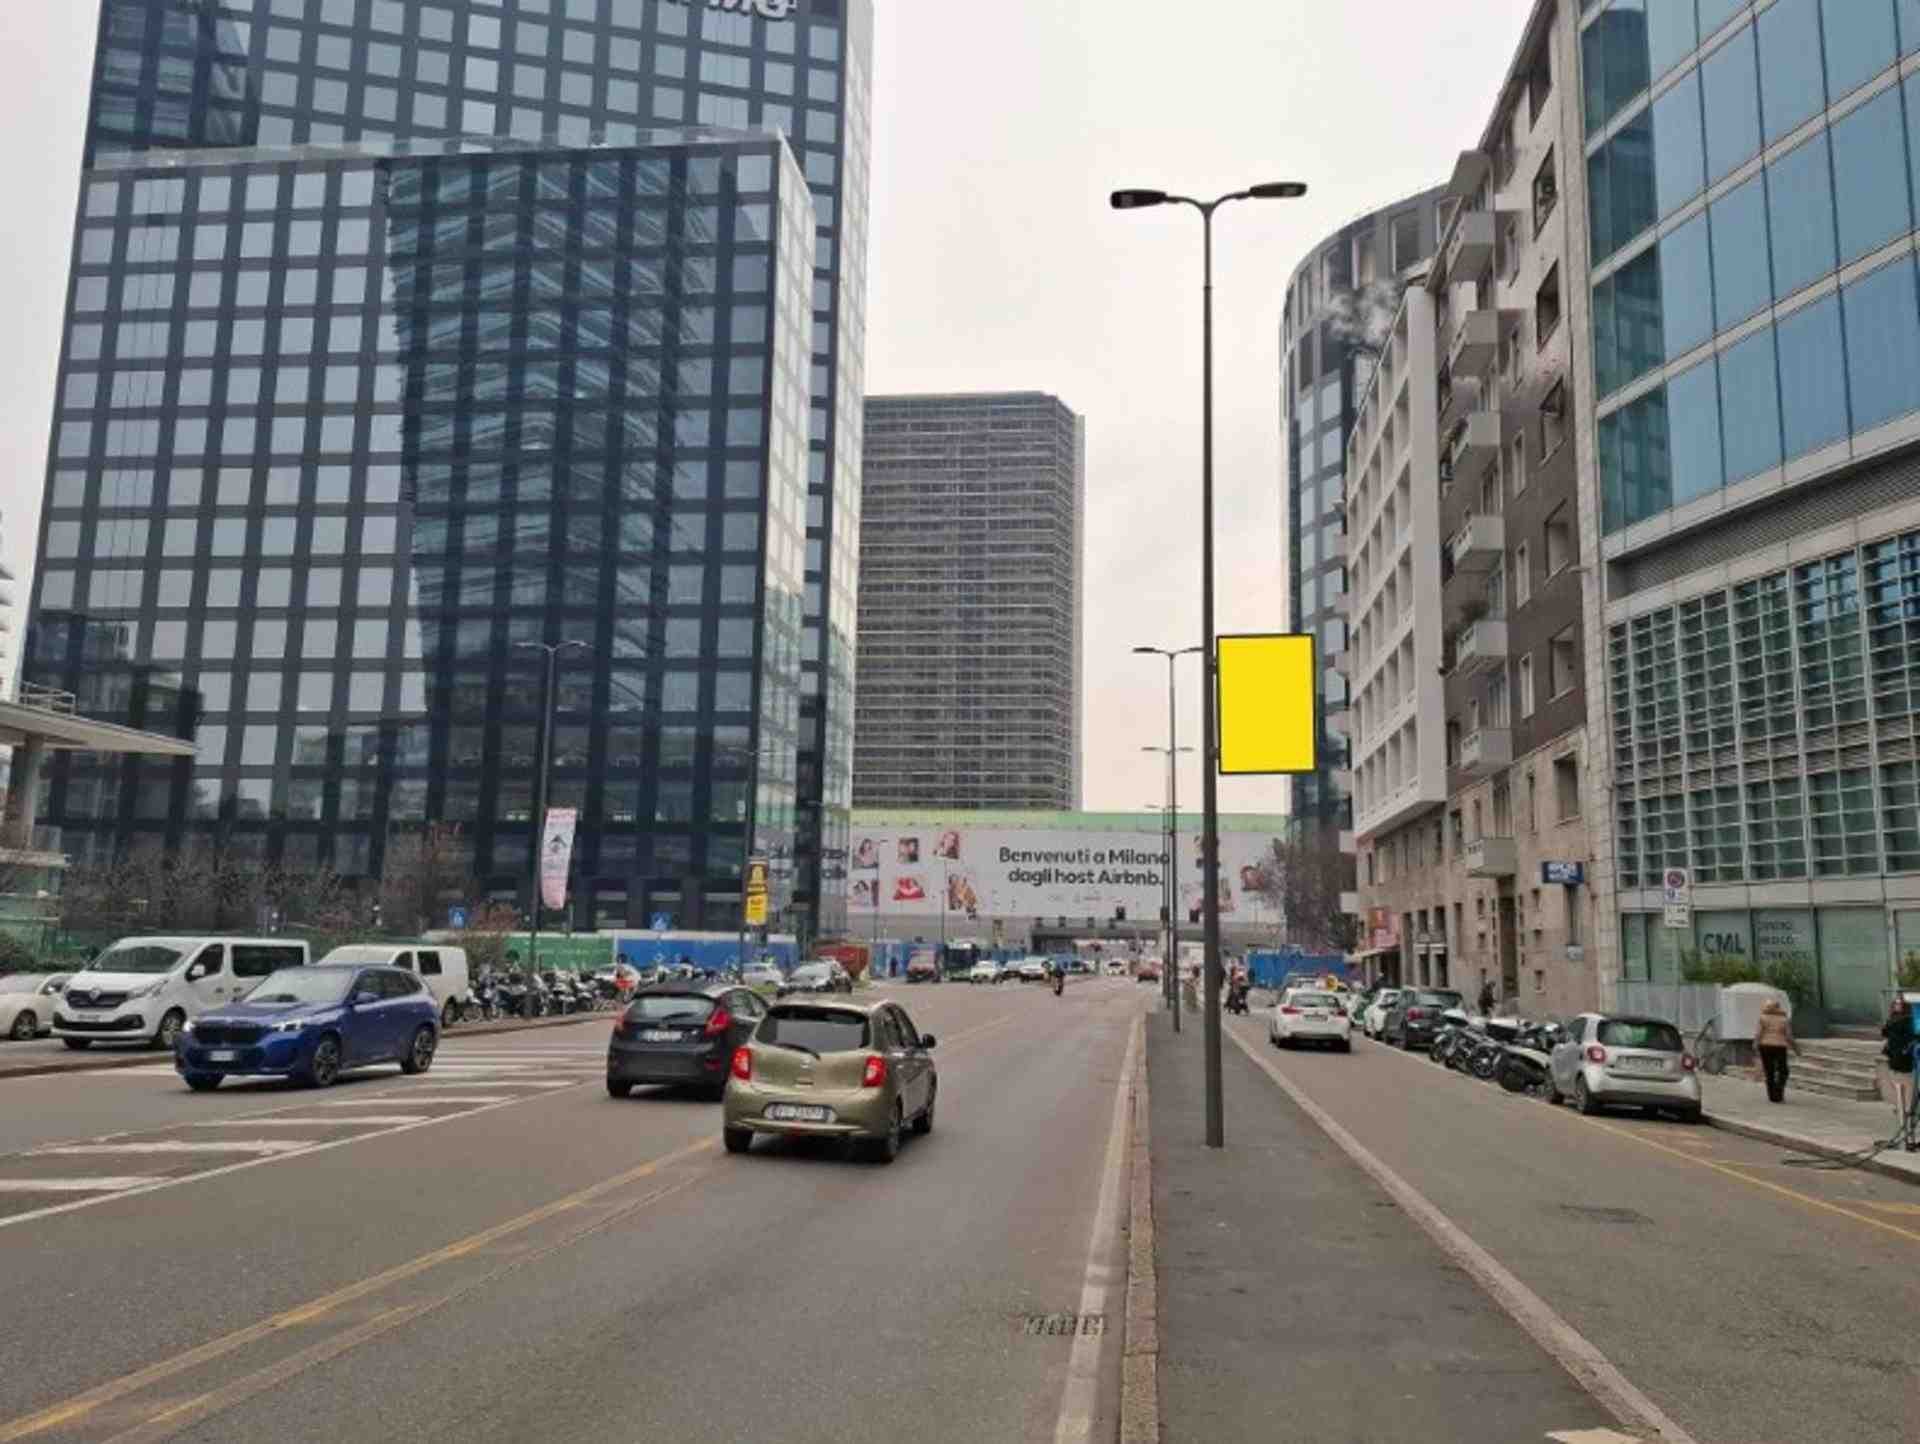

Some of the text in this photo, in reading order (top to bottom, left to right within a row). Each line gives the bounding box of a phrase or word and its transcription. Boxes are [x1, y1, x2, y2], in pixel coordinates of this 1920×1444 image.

[999, 847, 1170, 865] Benvenuti a Milano
[1008, 868, 1165, 887] dagli host Airbnb.
[1703, 933, 1745, 954] CML
